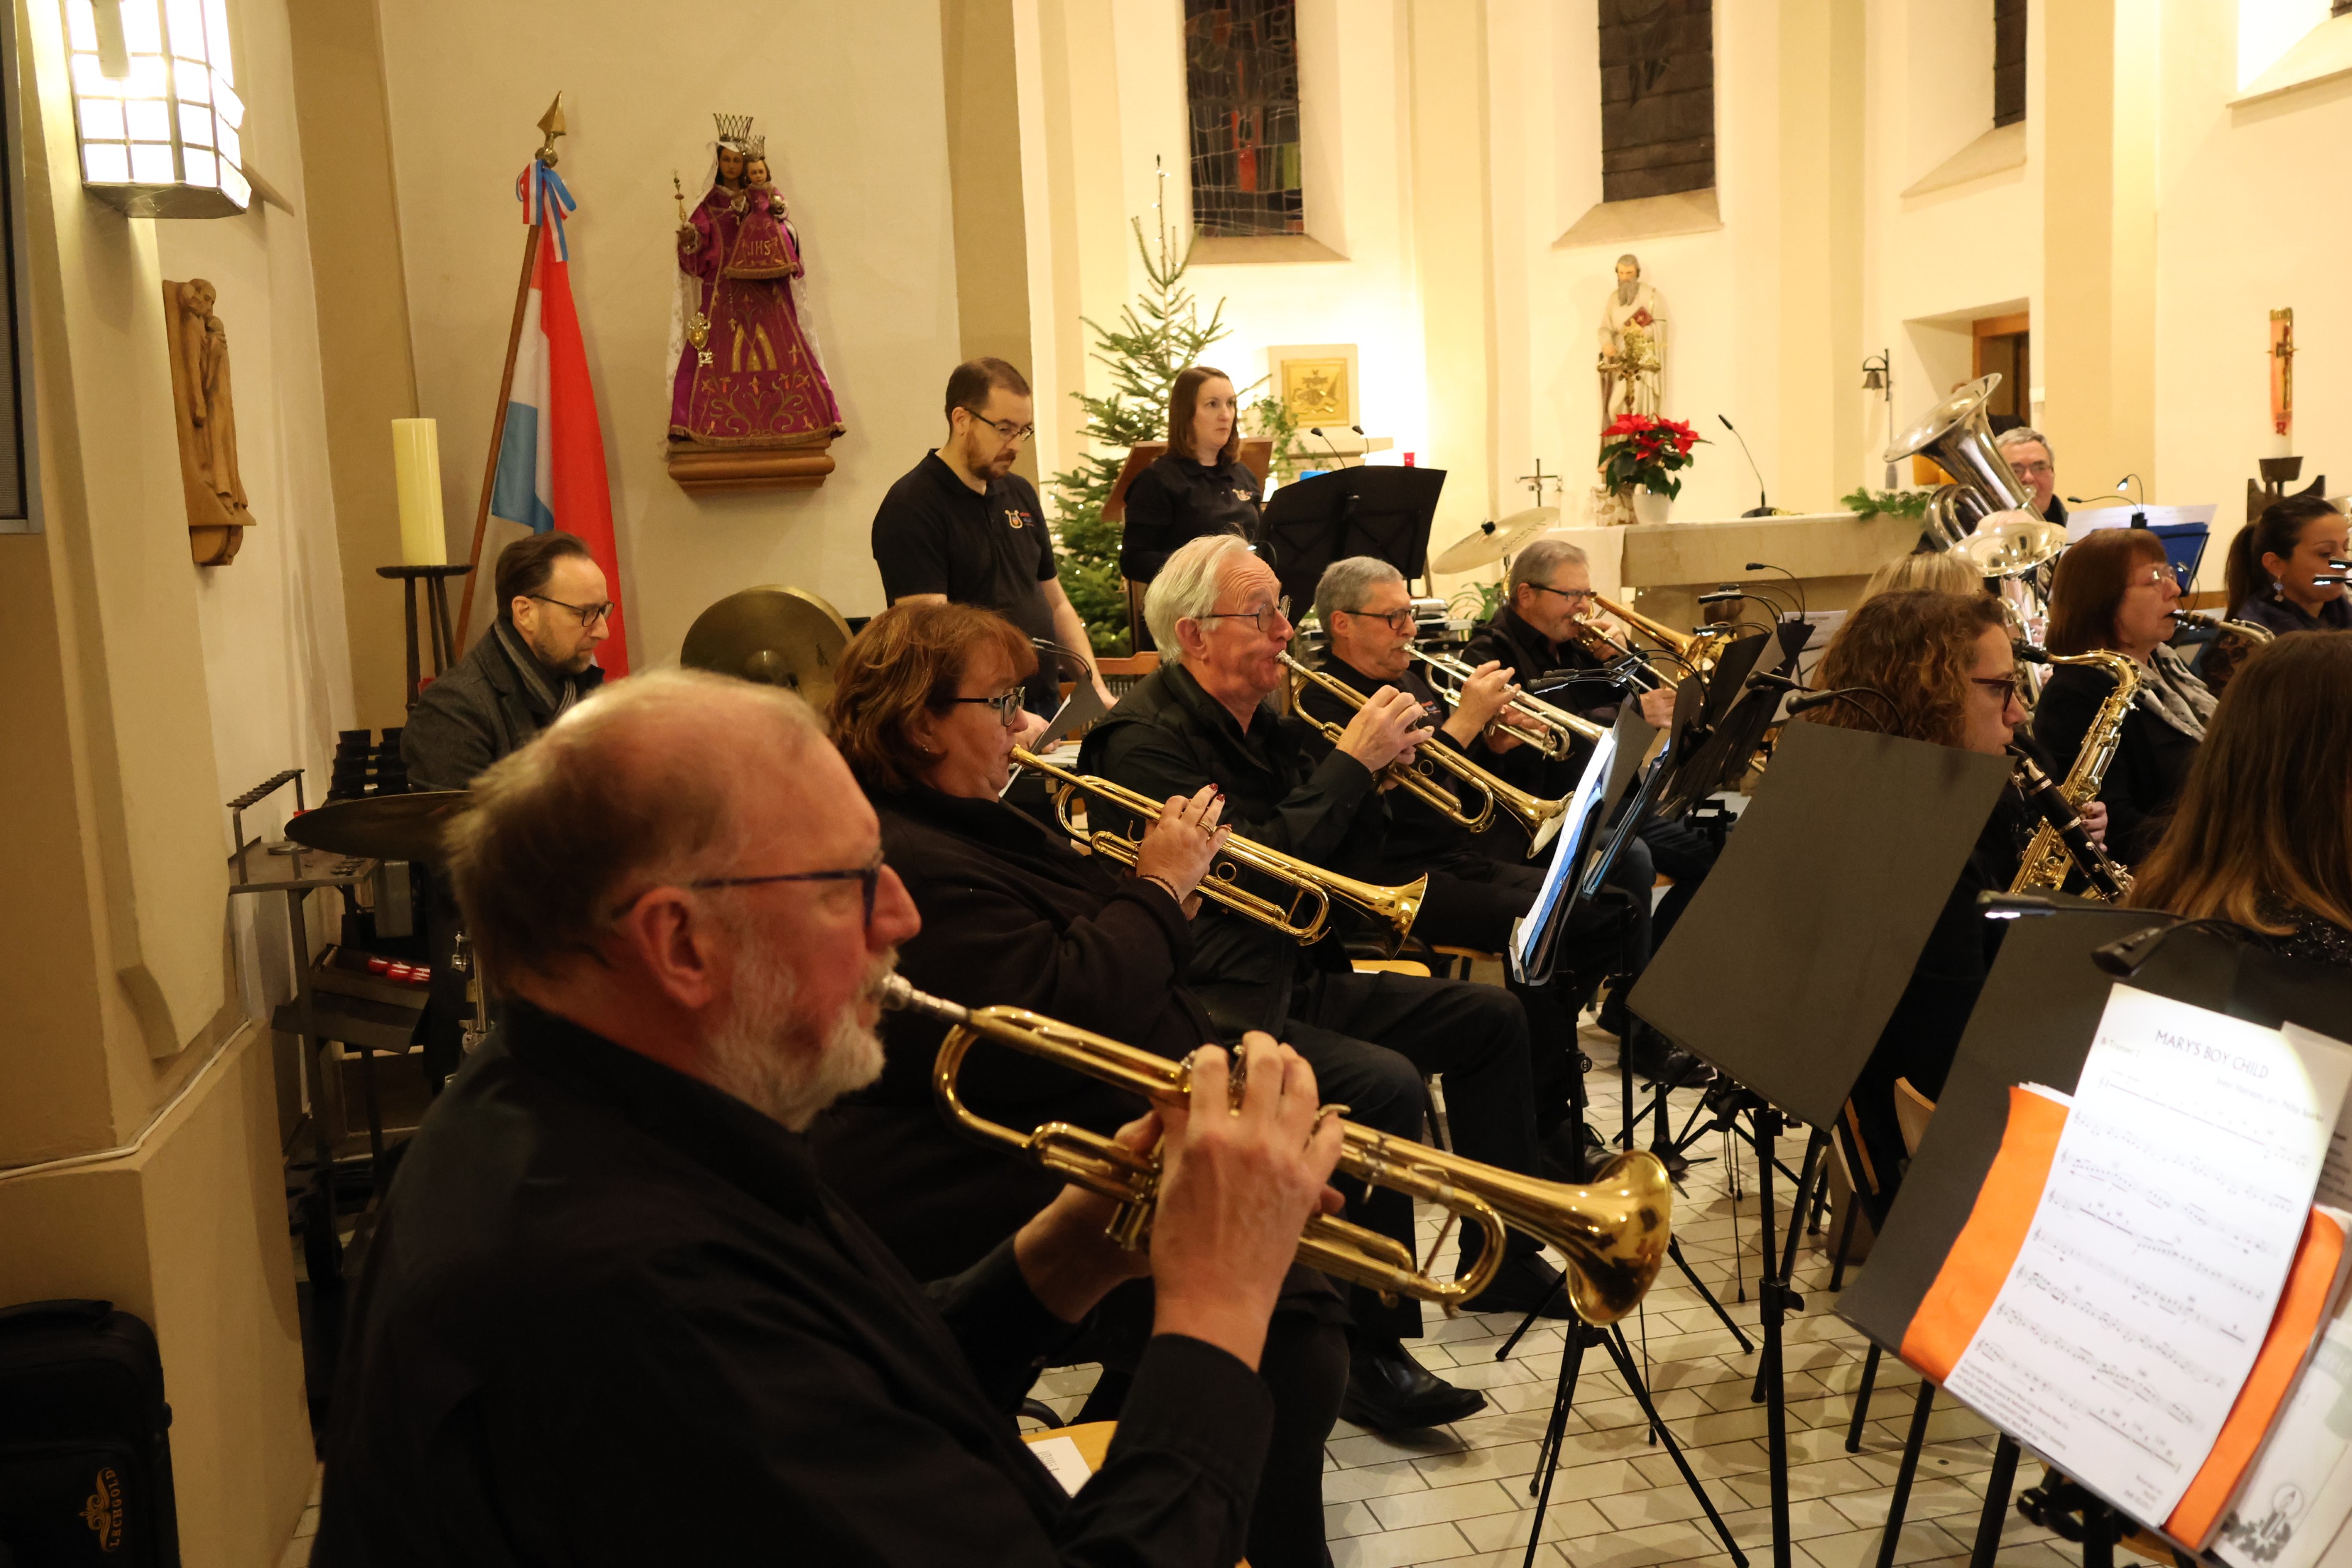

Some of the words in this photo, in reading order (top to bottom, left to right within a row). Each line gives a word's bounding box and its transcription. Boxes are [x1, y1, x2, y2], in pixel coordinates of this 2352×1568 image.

[747, 240, 771, 256] JHS
[2155, 1029, 2202, 1056] MARY'S
[2203, 1046, 2230, 1065] BOY
[2232, 1057, 2269, 1079] CHILD
